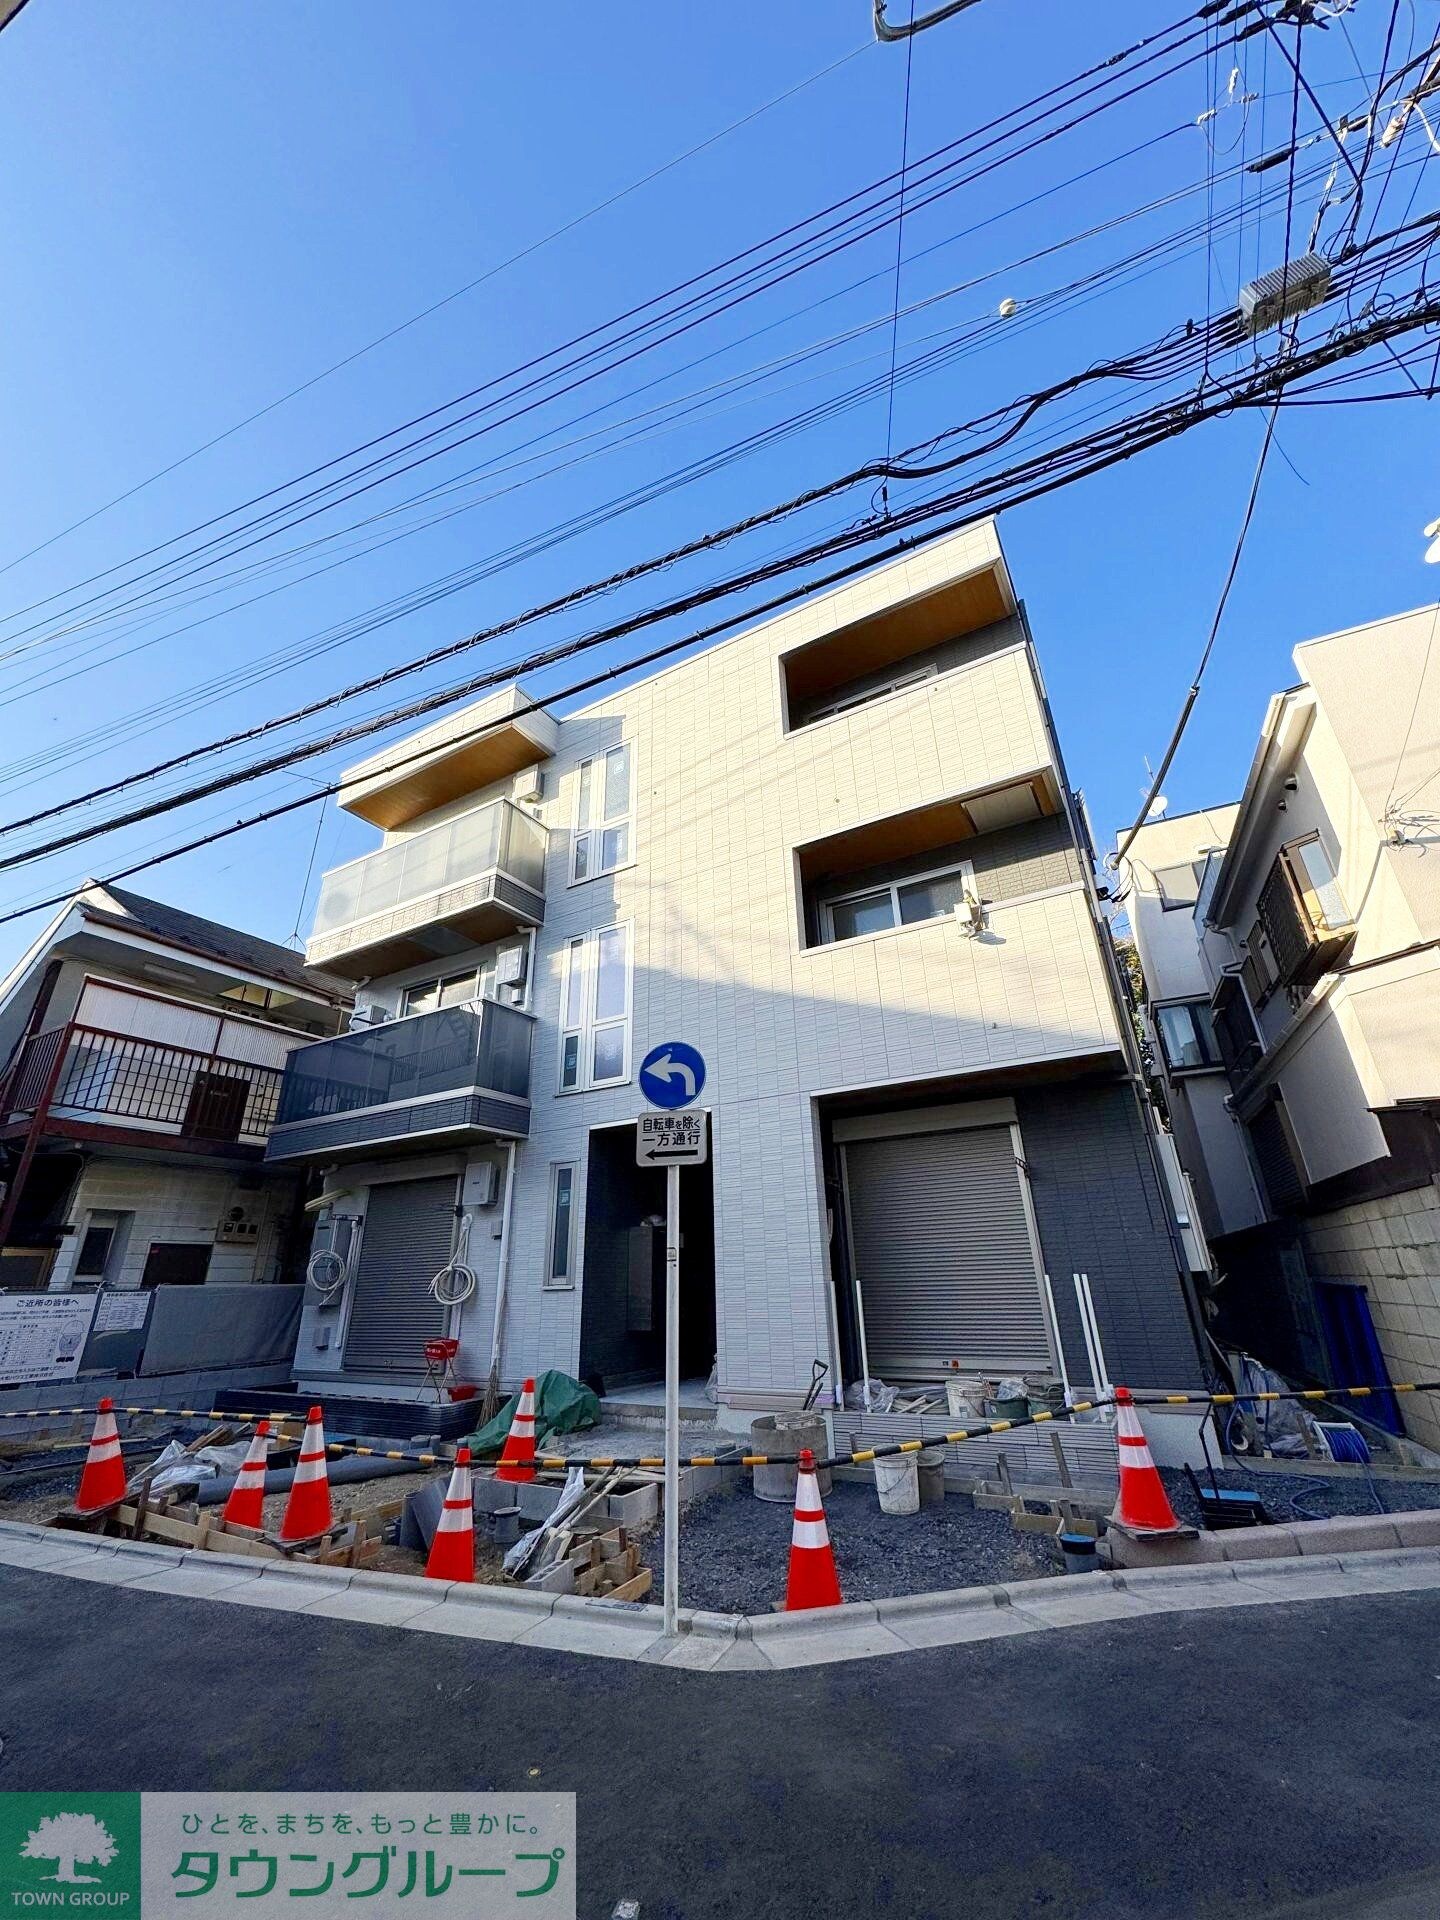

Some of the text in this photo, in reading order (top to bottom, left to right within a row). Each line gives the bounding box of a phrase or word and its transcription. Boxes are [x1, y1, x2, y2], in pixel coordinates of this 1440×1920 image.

[643, 1116, 700, 1131] 自転車を除く
[642, 1131, 701, 1147] 一方通行
[16, 1299, 79, 1308] ご近所の皆様へ
